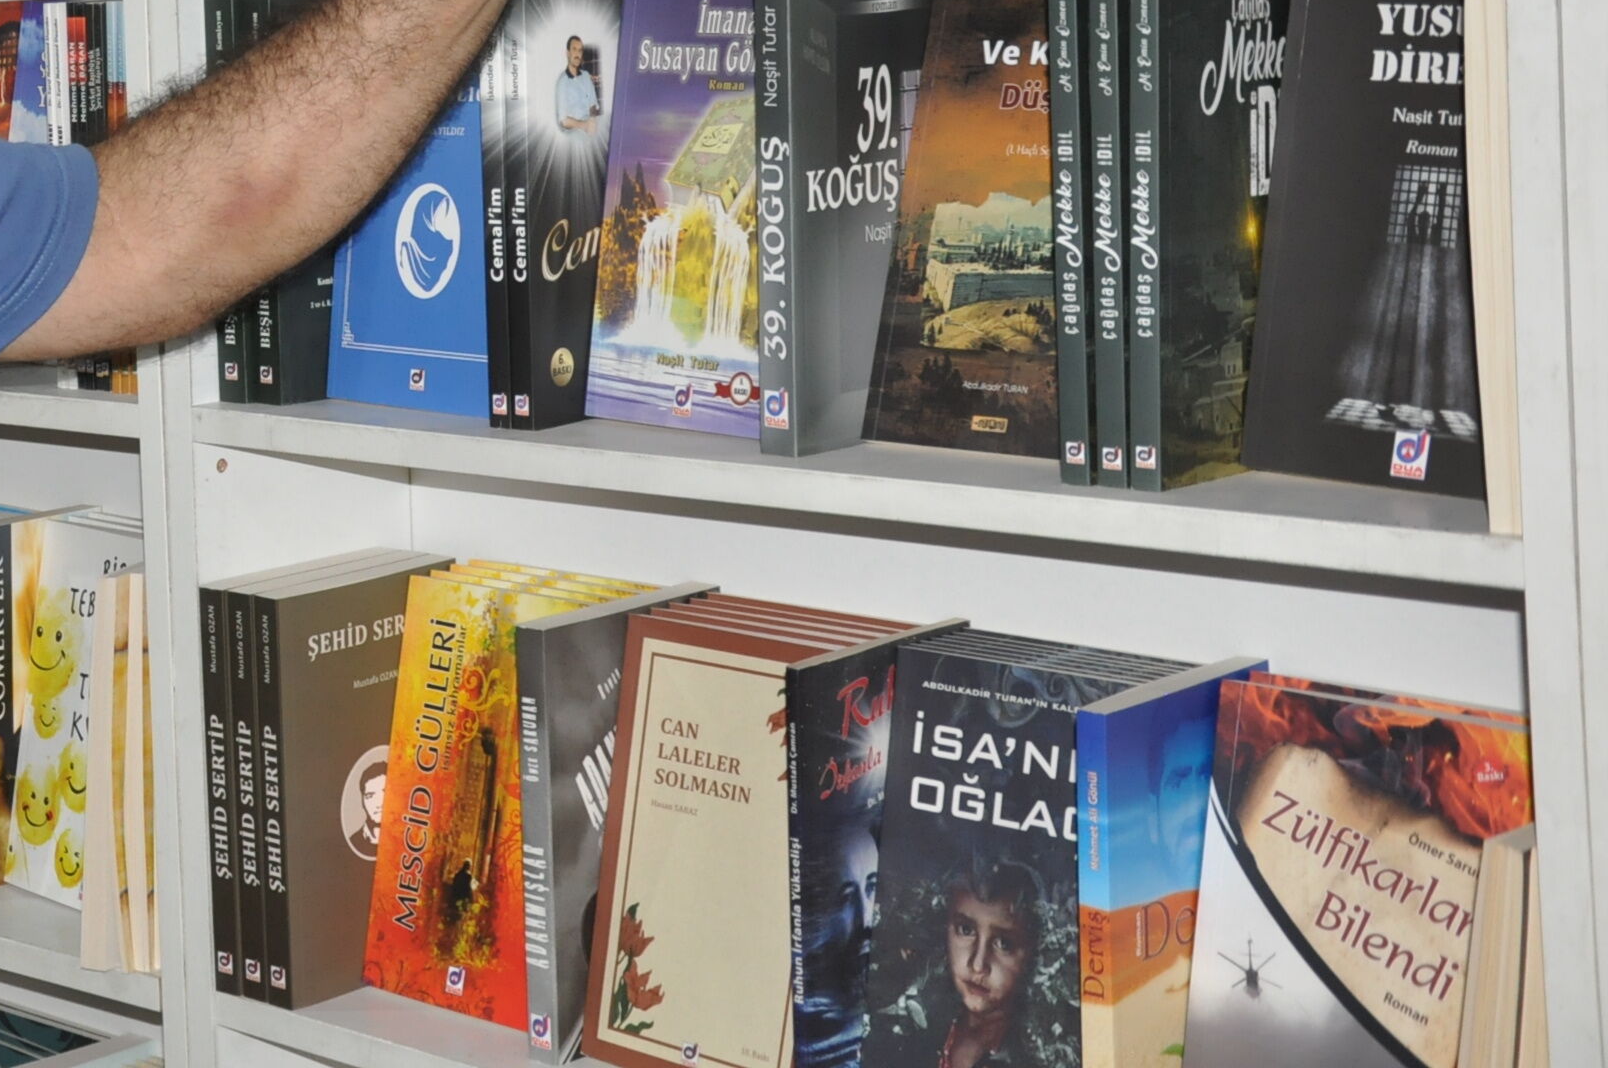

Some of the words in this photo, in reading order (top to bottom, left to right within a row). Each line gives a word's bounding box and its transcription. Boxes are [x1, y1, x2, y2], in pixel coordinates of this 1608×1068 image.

[762, 6, 777, 54] Tutar
[983, 39, 1026, 67] Ve
[638, 38, 718, 81] Susayan
[708, 79, 745, 92] Roman
[762, 60, 780, 108] Naşit
[857, 64, 899, 153] 39.
[1392, 107, 1433, 127] Naşit
[1406, 139, 1458, 157] Roman
[806, 153, 900, 214] KOĞUŞ
[757, 136, 789, 285] KOĞUŞ
[1055, 170, 1082, 267] Mekke
[488, 187, 505, 283] Cemal'im
[511, 187, 527, 283] Cemal'im
[1060, 272, 1081, 336] çağdaş
[763, 299, 787, 361] 39.
[656, 353, 685, 370] Naşit
[691, 357, 720, 372] Tutar
[1002, 382, 1028, 395] TURAN
[207, 605, 216, 634] OZAN
[307, 621, 368, 662] ŞEHİD
[209, 635, 218, 674] Mustafa
[922, 680, 991, 699] ABDULKADİR
[994, 692, 1049, 710] TURAN'IN
[661, 718, 699, 740] CAN
[208, 714, 227, 800] SERTİP
[393, 785, 433, 931] MESCİD
[414, 618, 457, 774] GÜLLERİ
[658, 743, 740, 776] LALELER
[654, 768, 751, 804] SOLMASIN
[211, 805, 233, 880] ŞEHİD
[1261, 790, 1474, 938] Zülfikarlar
[1408, 832, 1445, 861] Ömer
[1082, 911, 1111, 1000] Derviş
[1315, 889, 1459, 1002] Bilendi
